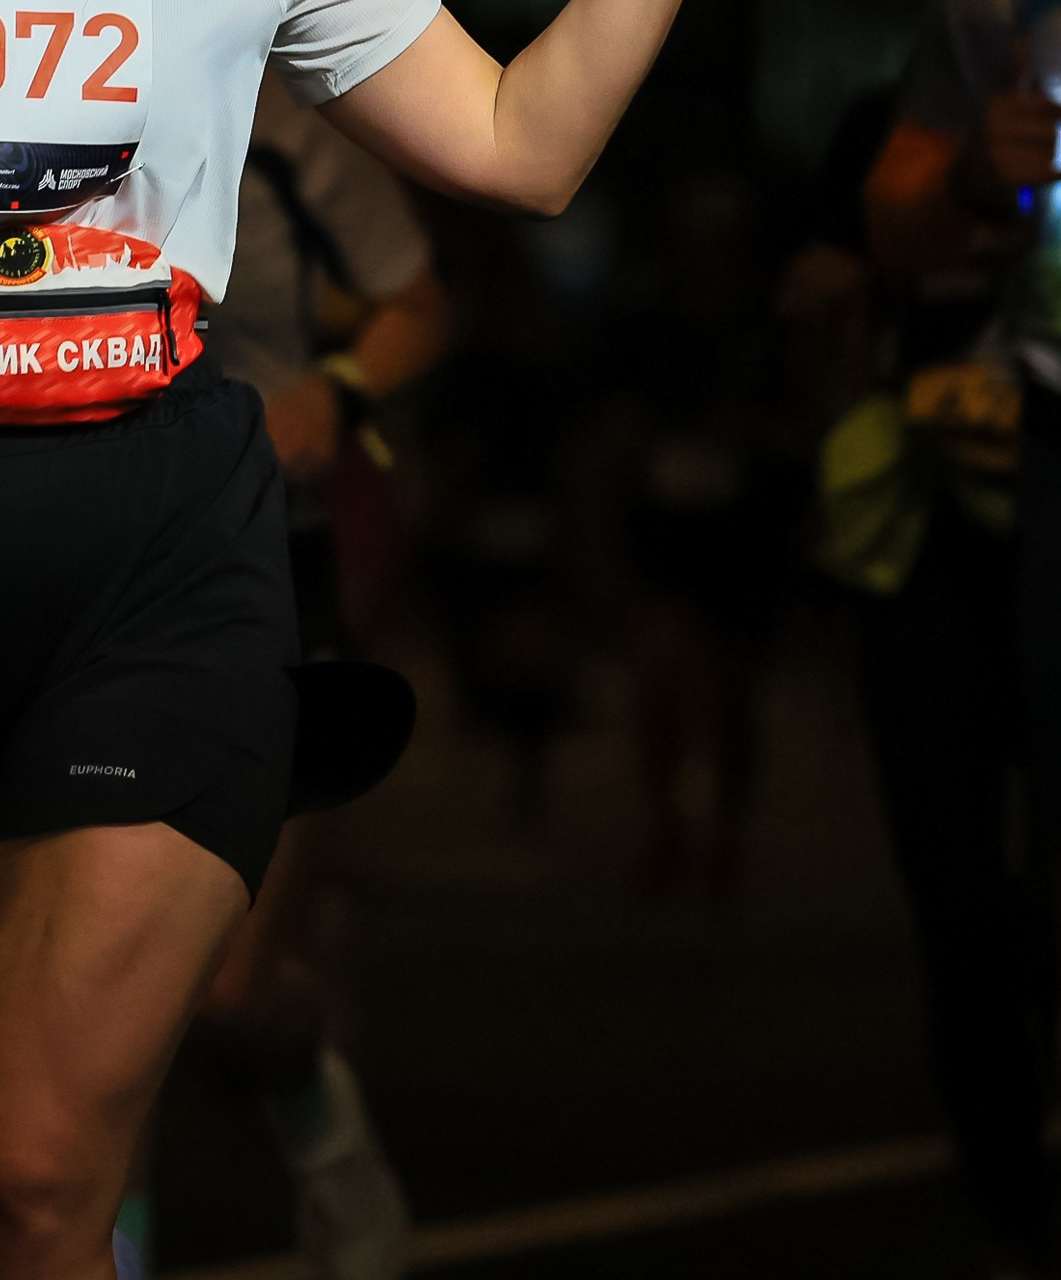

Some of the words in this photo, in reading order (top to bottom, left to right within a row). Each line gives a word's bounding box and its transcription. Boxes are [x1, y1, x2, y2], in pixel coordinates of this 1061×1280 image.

[59, 164, 109, 179] МОСКОВСКИЙ
[58, 178, 82, 191] СПОРТ
[56, 334, 161, 372] СКВАД
[69, 764, 136, 779] EUPHORIA
